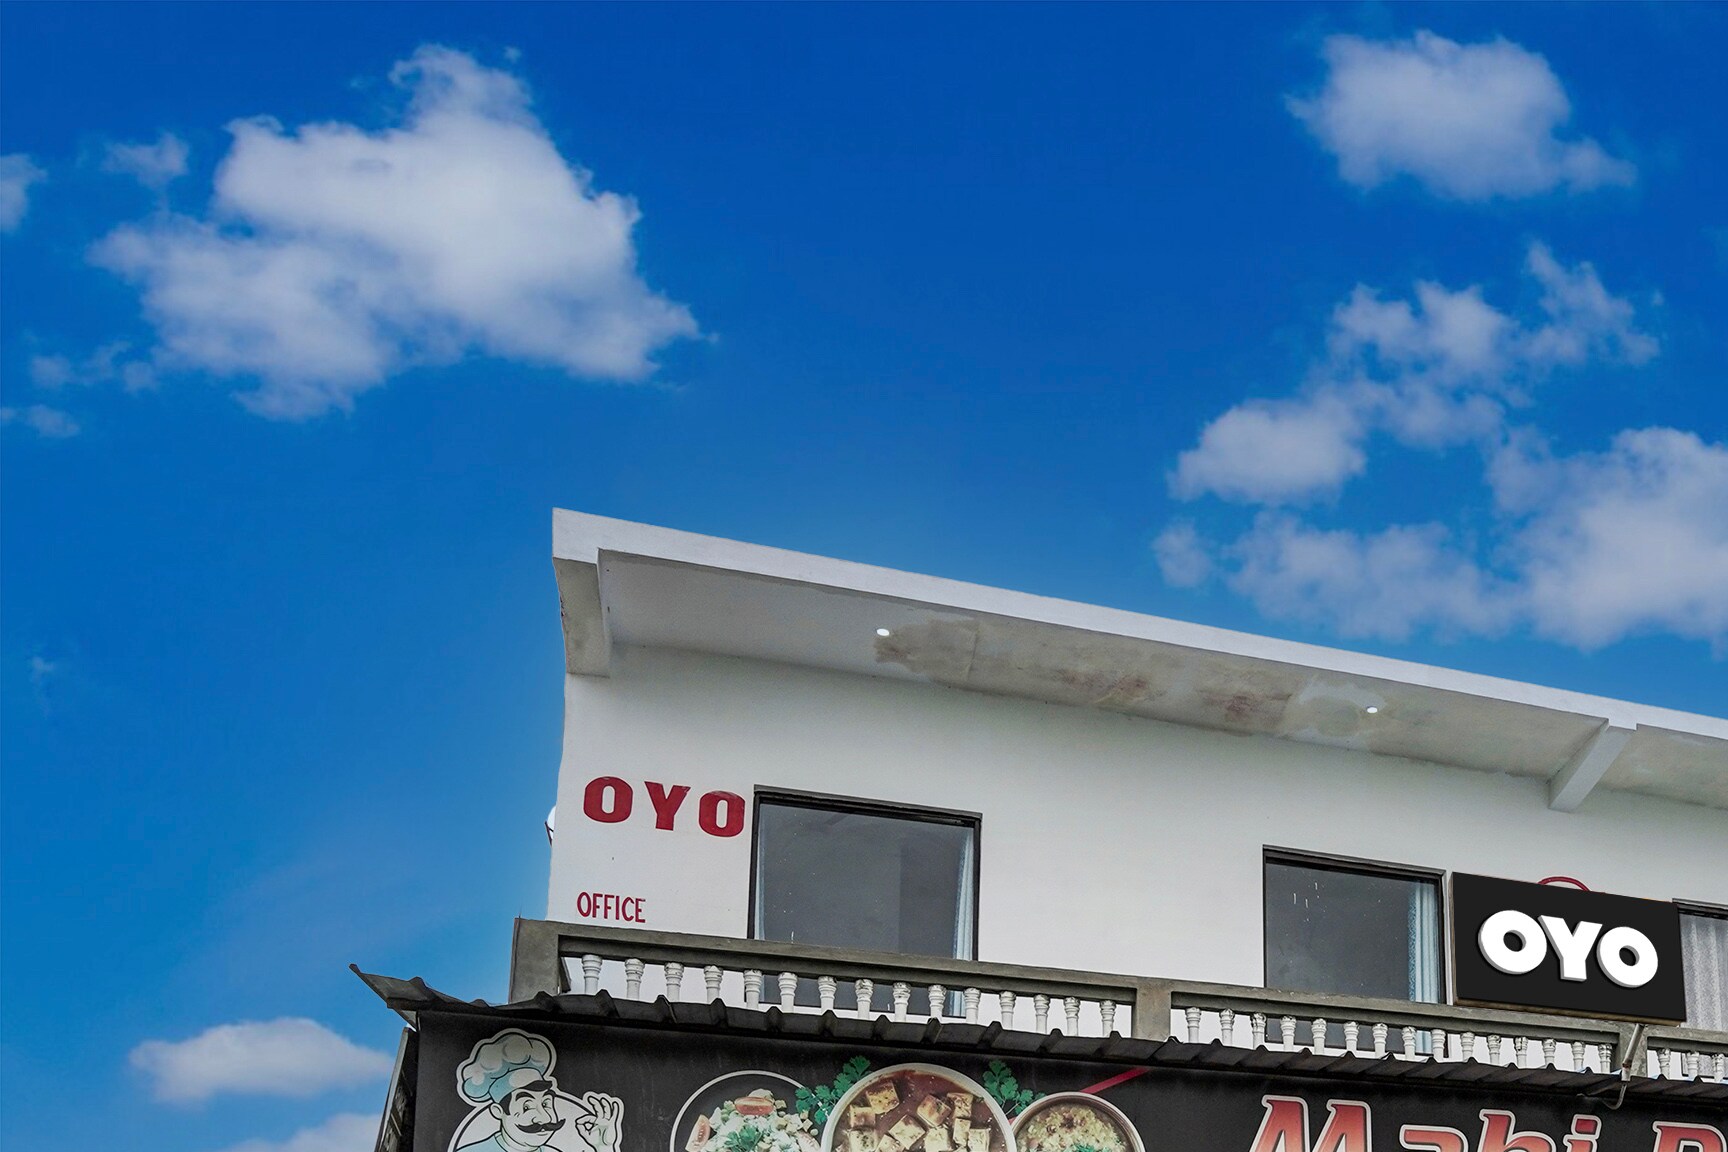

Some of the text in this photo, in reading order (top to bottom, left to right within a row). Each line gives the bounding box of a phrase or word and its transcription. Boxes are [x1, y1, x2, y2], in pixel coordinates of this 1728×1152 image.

[582, 776, 745, 838] OYO
[576, 891, 646, 924] OFFICE
[1478, 910, 1659, 988] OYO
